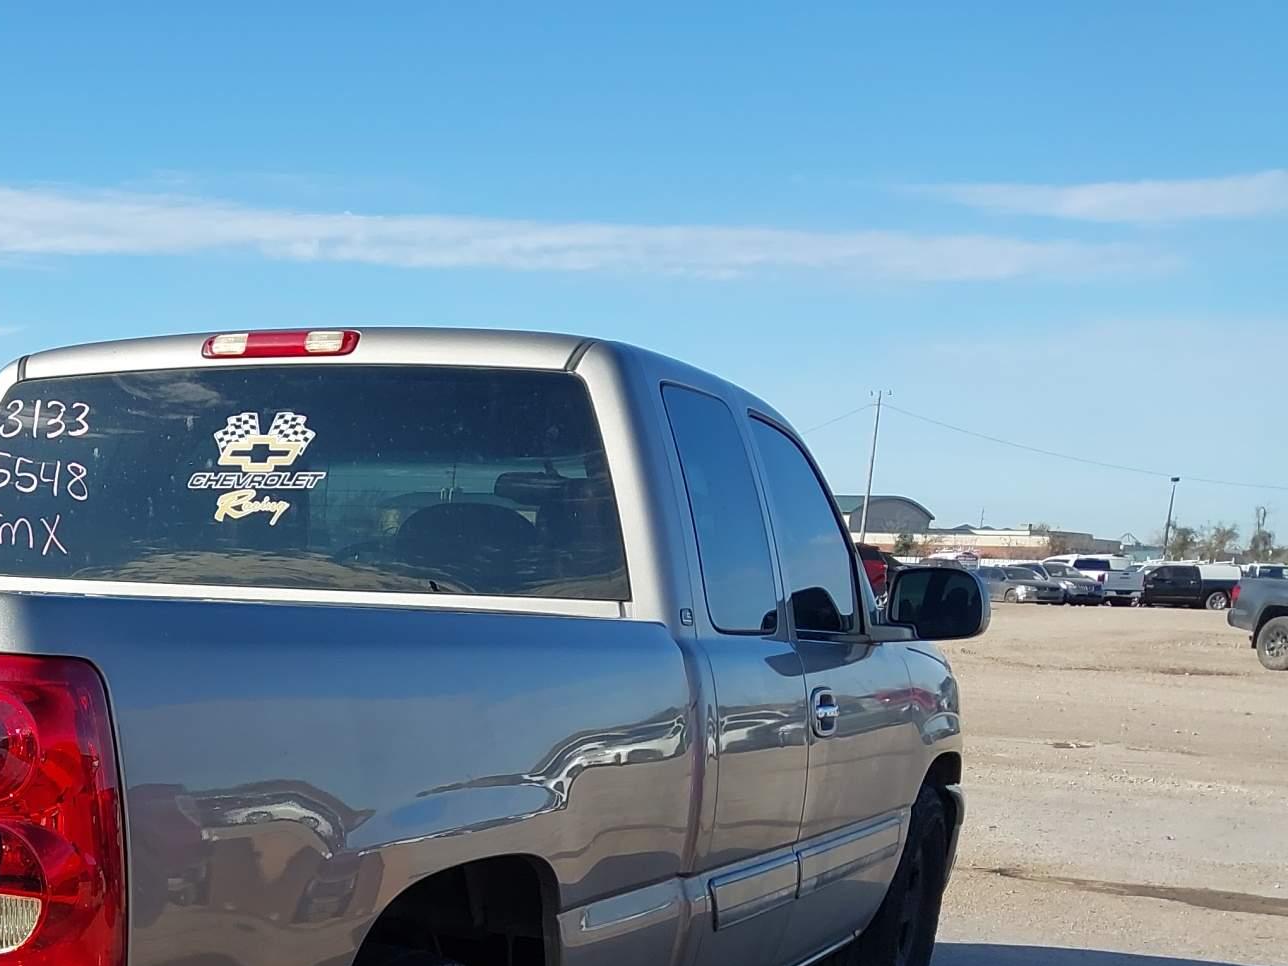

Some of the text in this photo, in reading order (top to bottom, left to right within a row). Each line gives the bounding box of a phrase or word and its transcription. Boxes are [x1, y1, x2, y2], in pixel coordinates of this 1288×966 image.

[0, 399, 90, 439] 3133
[187, 471, 327, 489] CHEVROLET
[214, 489, 291, 526] Racing
